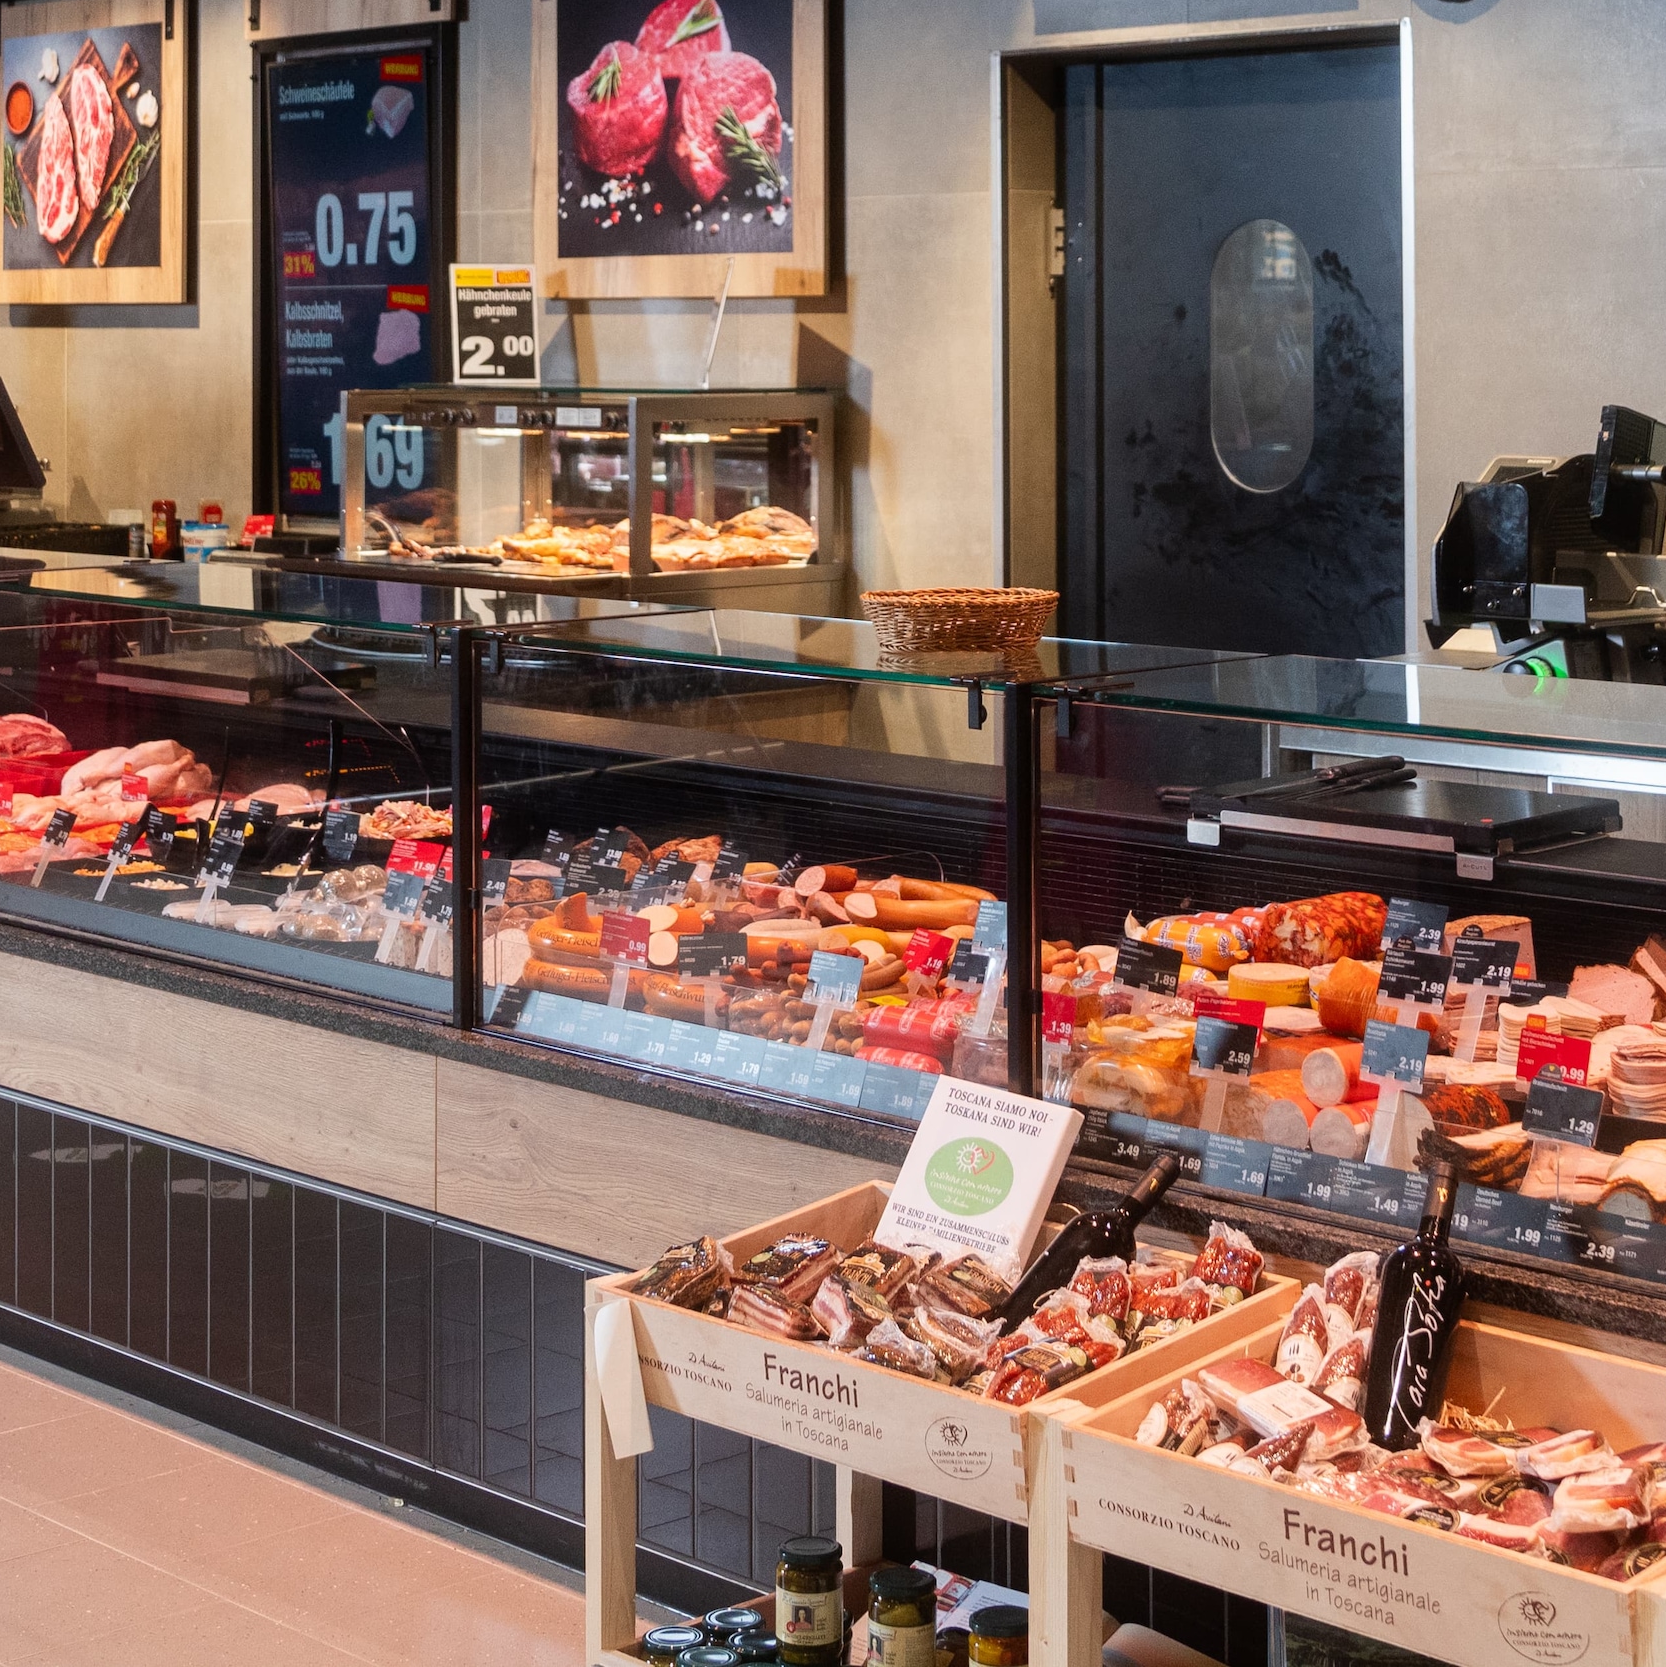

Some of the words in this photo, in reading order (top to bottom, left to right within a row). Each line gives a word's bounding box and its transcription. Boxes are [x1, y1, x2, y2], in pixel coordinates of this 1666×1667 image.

[279, 80, 355, 105] Schweineschäufele
[316, 190, 417, 268] 0.75
[284, 255, 315, 275] 31%
[457, 288, 532, 302] Hähnchenkeule
[285, 300, 345, 324] Kalbsschnitzel,
[473, 304, 518, 319] gebraten
[286, 328, 334, 349] Kalbsbraten
[290, 470, 321, 491] 26%
[1418, 927, 1441, 941] 2.39
[628, 940, 647, 953] 0.99
[1385, 955, 1415, 966] Schinkenwurst
[1153, 971, 1177, 988] 1.89
[1487, 964, 1512, 978] 2.19
[1420, 980, 1445, 995] 1.99
[1051, 1020, 1072, 1035] 1.39
[1228, 1049, 1252, 1066] 2.59
[1399, 1056, 1423, 1072] 2.19
[948, 1087, 992, 1109] TOSCANA
[994, 1099, 1027, 1117] SIAMO
[1028, 1109, 1048, 1124] NOI
[944, 1102, 988, 1124] TOSKANA
[990, 1115, 1016, 1131] SIND
[1018, 1122, 1042, 1138] WIR!
[1568, 1117, 1595, 1135] 1.29
[1117, 1141, 1140, 1157] 3.49
[1179, 1155, 1202, 1171] 1.69
[1241, 1169, 1265, 1185] 1.69
[1307, 1182, 1331, 1198] 1.99
[1477, 1187, 1499, 1199] Deutsches
[892, 1202, 906, 1212] WIR
[907, 1206, 925, 1219] SIND
[925, 1212, 938, 1223] EIN
[1374, 1196, 1399, 1213] 1.49
[896, 1216, 926, 1232] KLEINER
[1514, 1226, 1541, 1244] 1.99
[1586, 1241, 1615, 1260] 2.39
[682, 1369, 732, 1393] TOSCANO
[763, 1352, 859, 1408] Franchi
[745, 1383, 808, 1416] Salumeria
[812, 1406, 883, 1440] artigianale
[781, 1415, 793, 1432] in
[795, 1420, 849, 1452] Toscana
[1098, 1497, 1173, 1531] CONSORZIO
[1176, 1520, 1240, 1552] TOSCANO
[1283, 1508, 1410, 1577] Franchi
[1258, 1541, 1341, 1584] Salumeria
[1347, 1571, 1441, 1615] artigianale
[1305, 1581, 1320, 1602] in
[1323, 1587, 1395, 1627] Toscana
